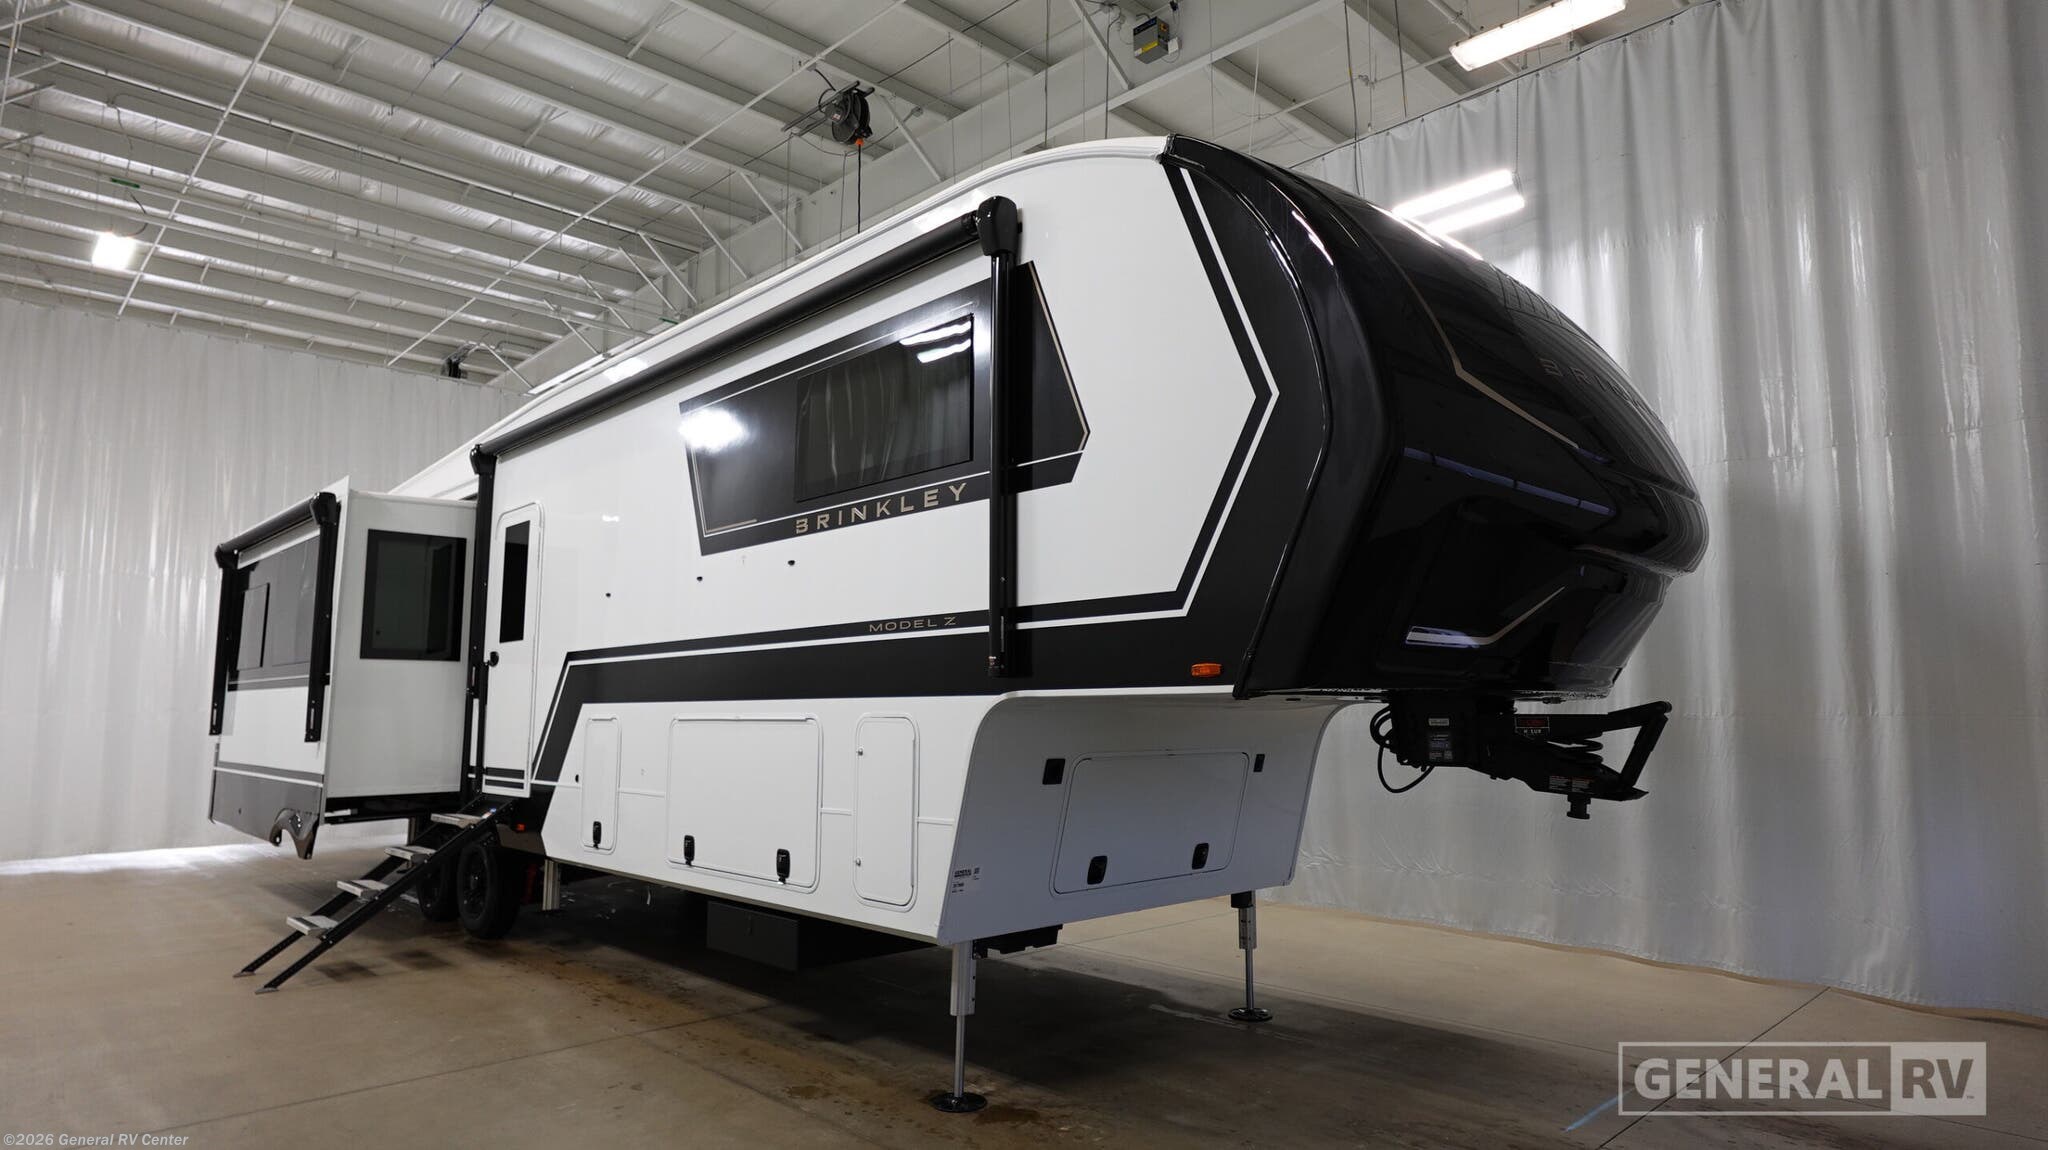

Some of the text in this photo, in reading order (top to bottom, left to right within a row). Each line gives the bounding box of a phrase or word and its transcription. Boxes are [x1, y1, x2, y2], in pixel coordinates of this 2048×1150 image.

[796, 482, 967, 533] BRINKLEY
[869, 616, 957, 633] MODEL Z
